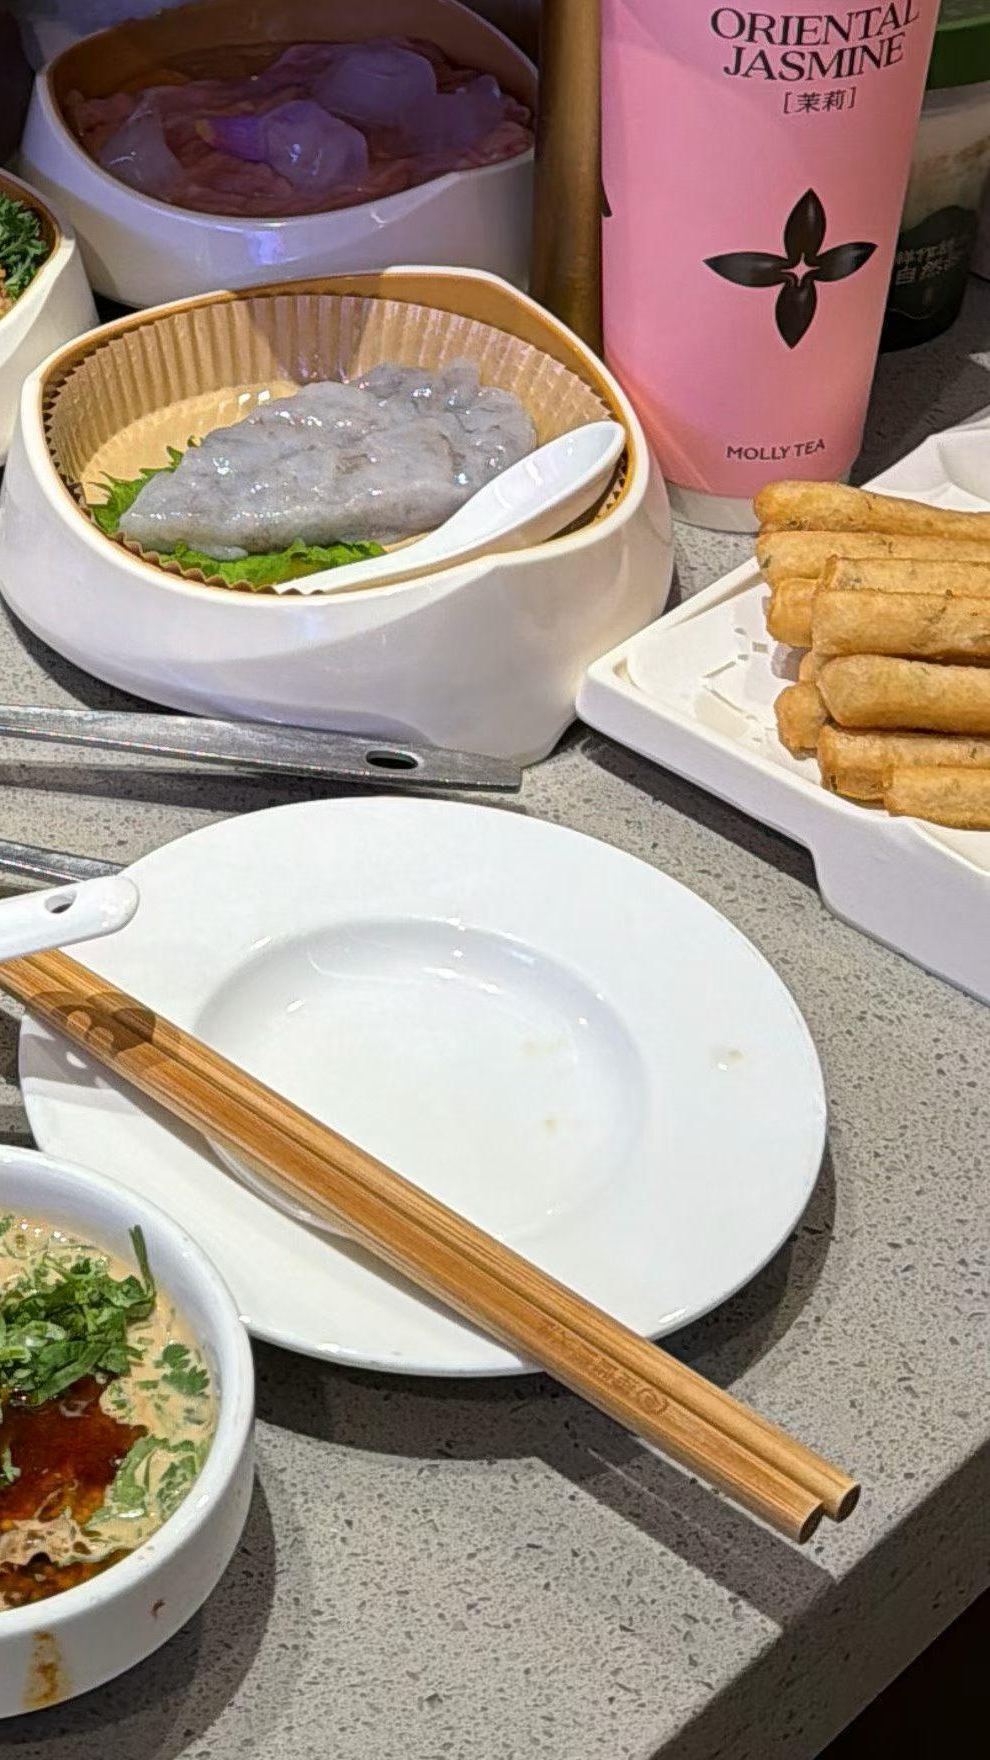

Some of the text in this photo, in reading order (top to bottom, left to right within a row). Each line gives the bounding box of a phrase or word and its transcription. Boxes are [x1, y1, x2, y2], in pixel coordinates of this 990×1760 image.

[723, 32, 907, 82] JASMINE
[726, 438, 826, 461] MOLLY TEA
